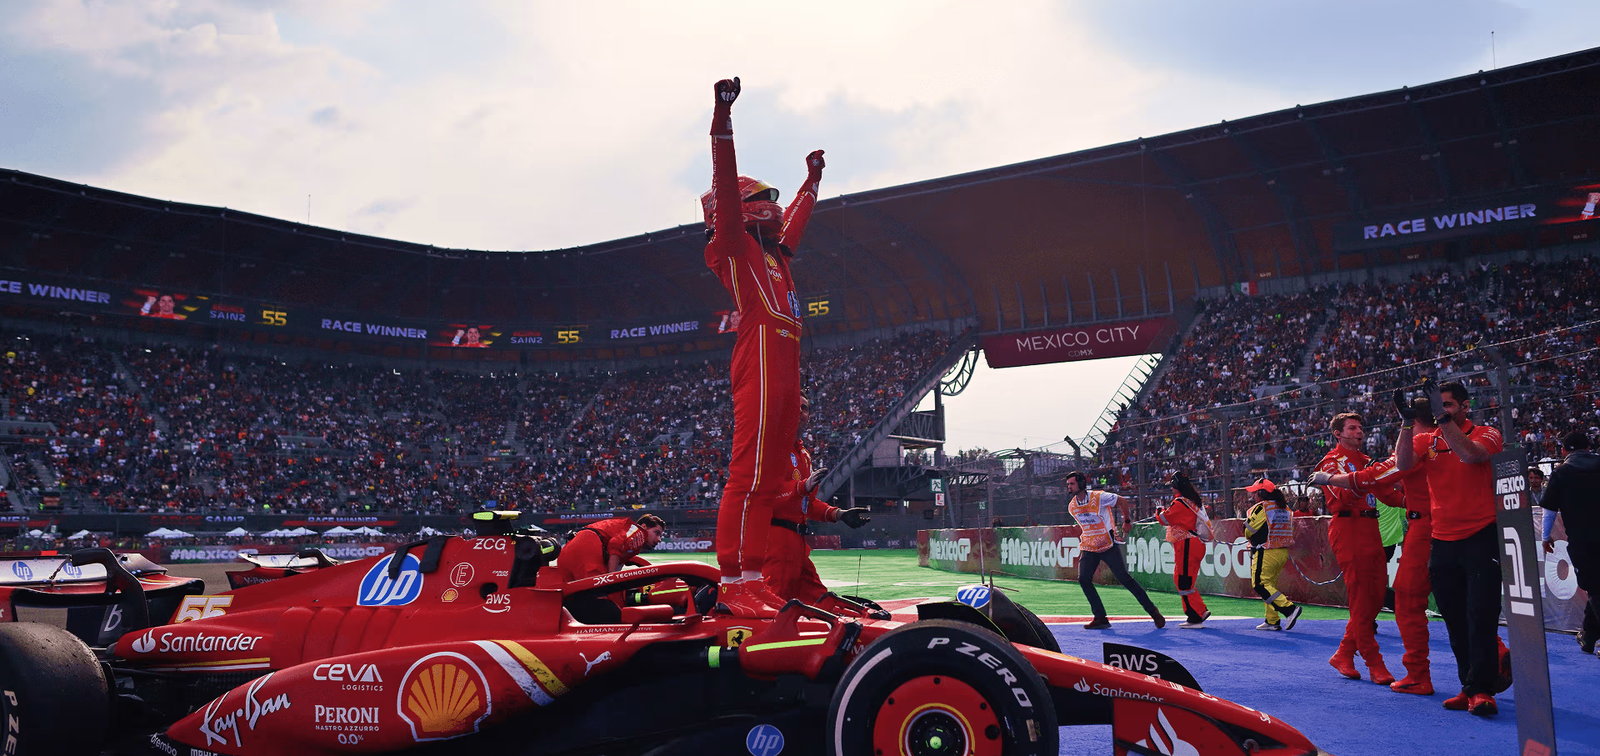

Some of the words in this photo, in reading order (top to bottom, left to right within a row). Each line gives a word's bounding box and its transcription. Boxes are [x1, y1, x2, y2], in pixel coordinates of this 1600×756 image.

[1363, 218, 1426, 240] RACE
[1433, 203, 1537, 229] WINNER
[28, 283, 111, 304] WINNER
[262, 310, 288, 326] 55
[808, 300, 829, 317] 55
[321, 319, 362, 333] RACE
[366, 323, 427, 339] WINNER
[557, 330, 580, 344] 55
[610, 326, 646, 339] RACE
[650, 320, 699, 336] WINNER
[1016, 331, 1090, 353] MEXICO
[1096, 325, 1140, 345] CITY
[1068, 349, 1093, 358] CDMX
[1496, 475, 1526, 495] MEXICO
[473, 538, 507, 551] ZCG
[1000, 536, 1080, 568] #MexicoGP
[1126, 535, 1251, 579] #MecoG
[16, 563, 31, 579] hp
[364, 554, 418, 606] hp
[593, 574, 615, 586] DXC
[616, 567, 659, 579] TECHNOLOGY
[485, 593, 511, 605] aws
[175, 595, 235, 624] 55
[159, 632, 263, 653] Santander
[927, 637, 950, 649] P
[955, 642, 1033, 707] ZERO
[1109, 653, 1159, 672] aws
[3, 689, 19, 706] P
[341, 684, 384, 692] LOGISTICS
[315, 704, 380, 724] PERONI
[337, 733, 364, 745] 0.0%
[753, 724, 778, 756] hp
